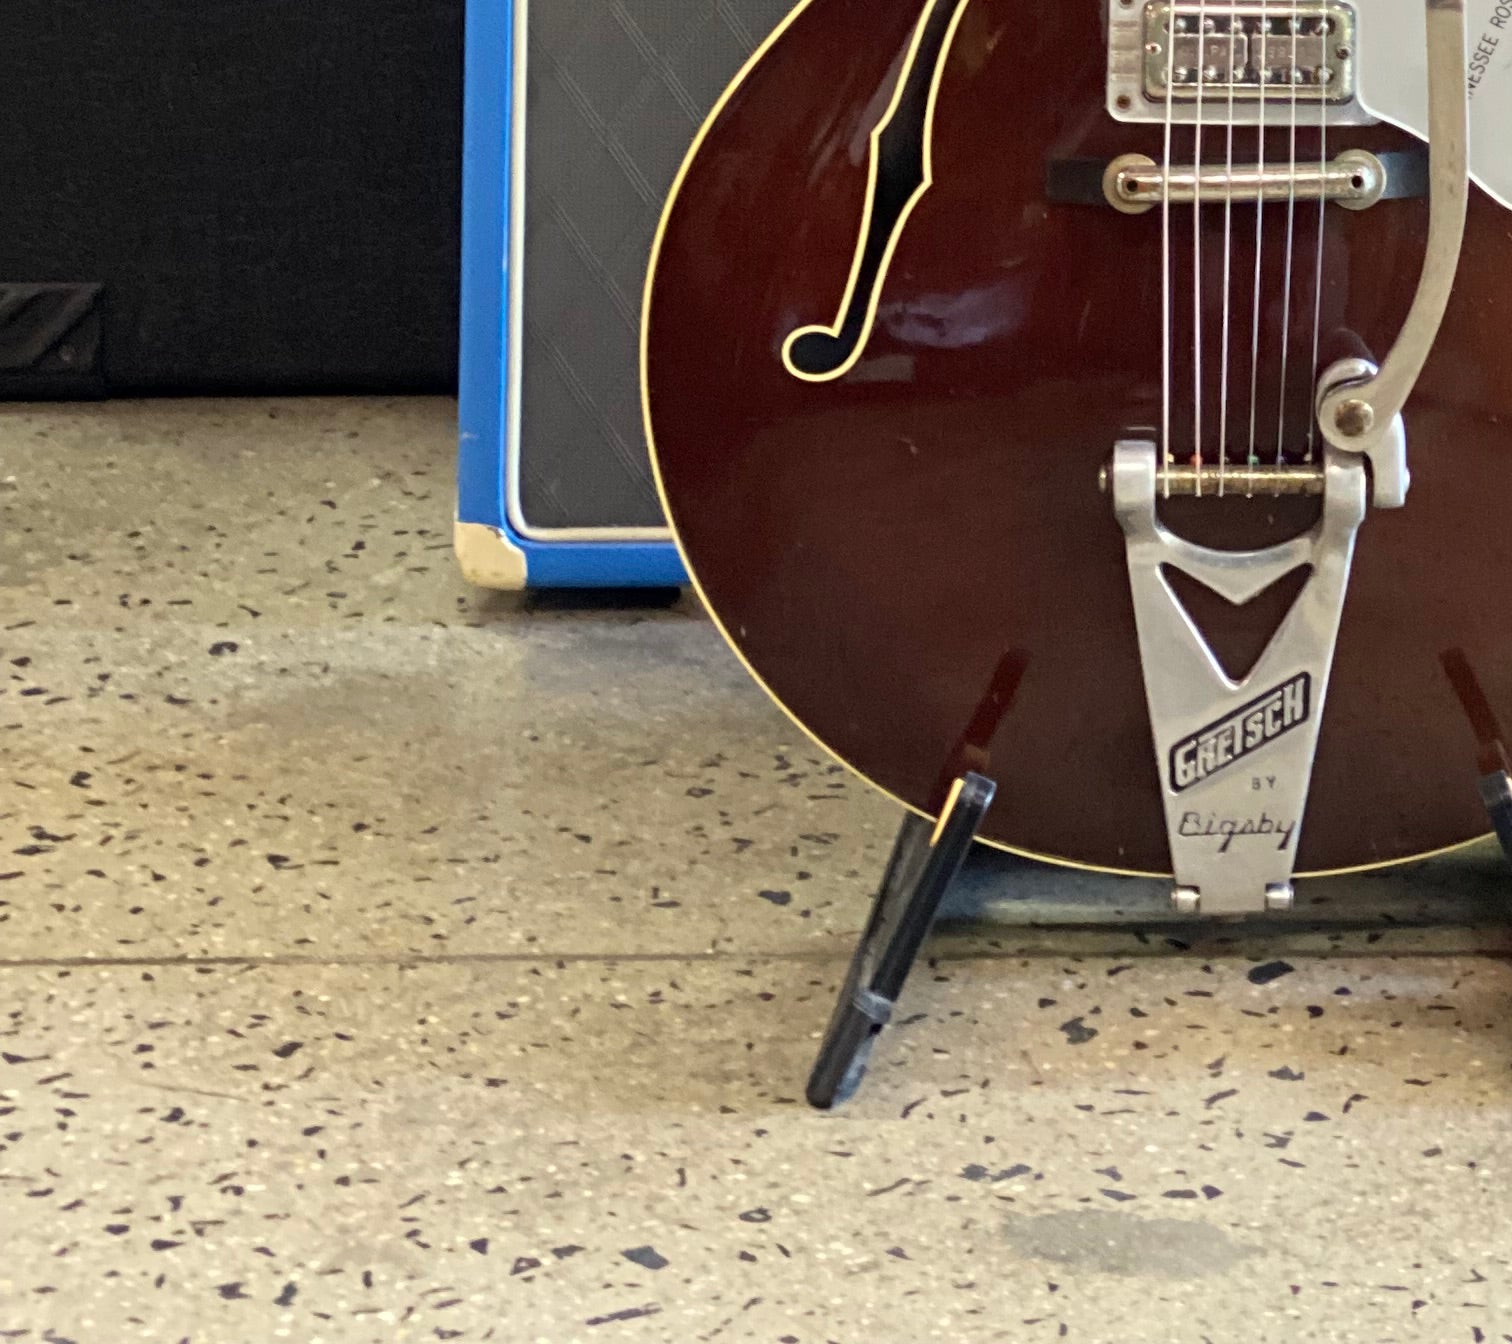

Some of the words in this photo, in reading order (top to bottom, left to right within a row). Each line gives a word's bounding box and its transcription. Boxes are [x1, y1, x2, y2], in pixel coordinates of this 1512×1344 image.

[1173, 677, 1307, 791] GRETSCH
[1251, 776, 1276, 791] BY
[1179, 810, 1297, 853] Bigsby
